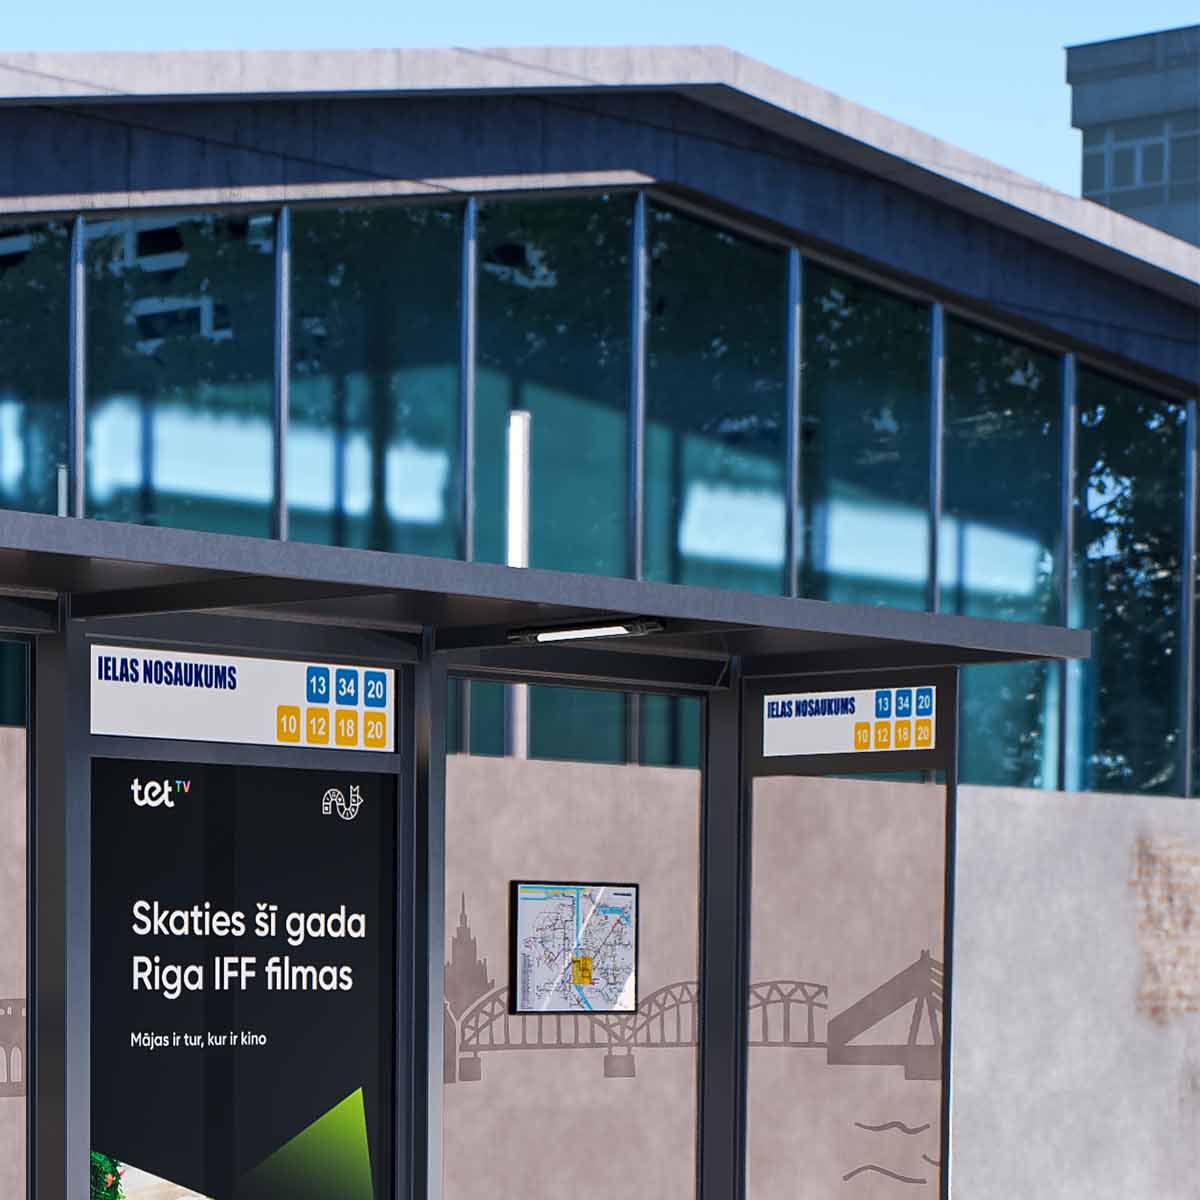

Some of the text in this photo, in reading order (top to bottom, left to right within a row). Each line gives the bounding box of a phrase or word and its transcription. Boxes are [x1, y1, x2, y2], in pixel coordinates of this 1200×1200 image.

[98, 656, 237, 690] IELAS NOSAUKUMS
[310, 675, 383, 699] 13 34 20
[767, 697, 855, 719] IELAS NOSAUKUMS
[878, 695, 930, 711] 13 34 20
[281, 715, 383, 739] 10 12 18 20
[857, 730, 868, 743] 10
[877, 729, 888, 742] 12
[917, 727, 929, 740] 20
[130, 777, 191, 808] tet TV
[132, 900, 366, 946] Skaties šī gada
[132, 955, 353, 999] Riga IFF filmas
[130, 1031, 267, 1050] Mājas ir tur, kur ir kino
